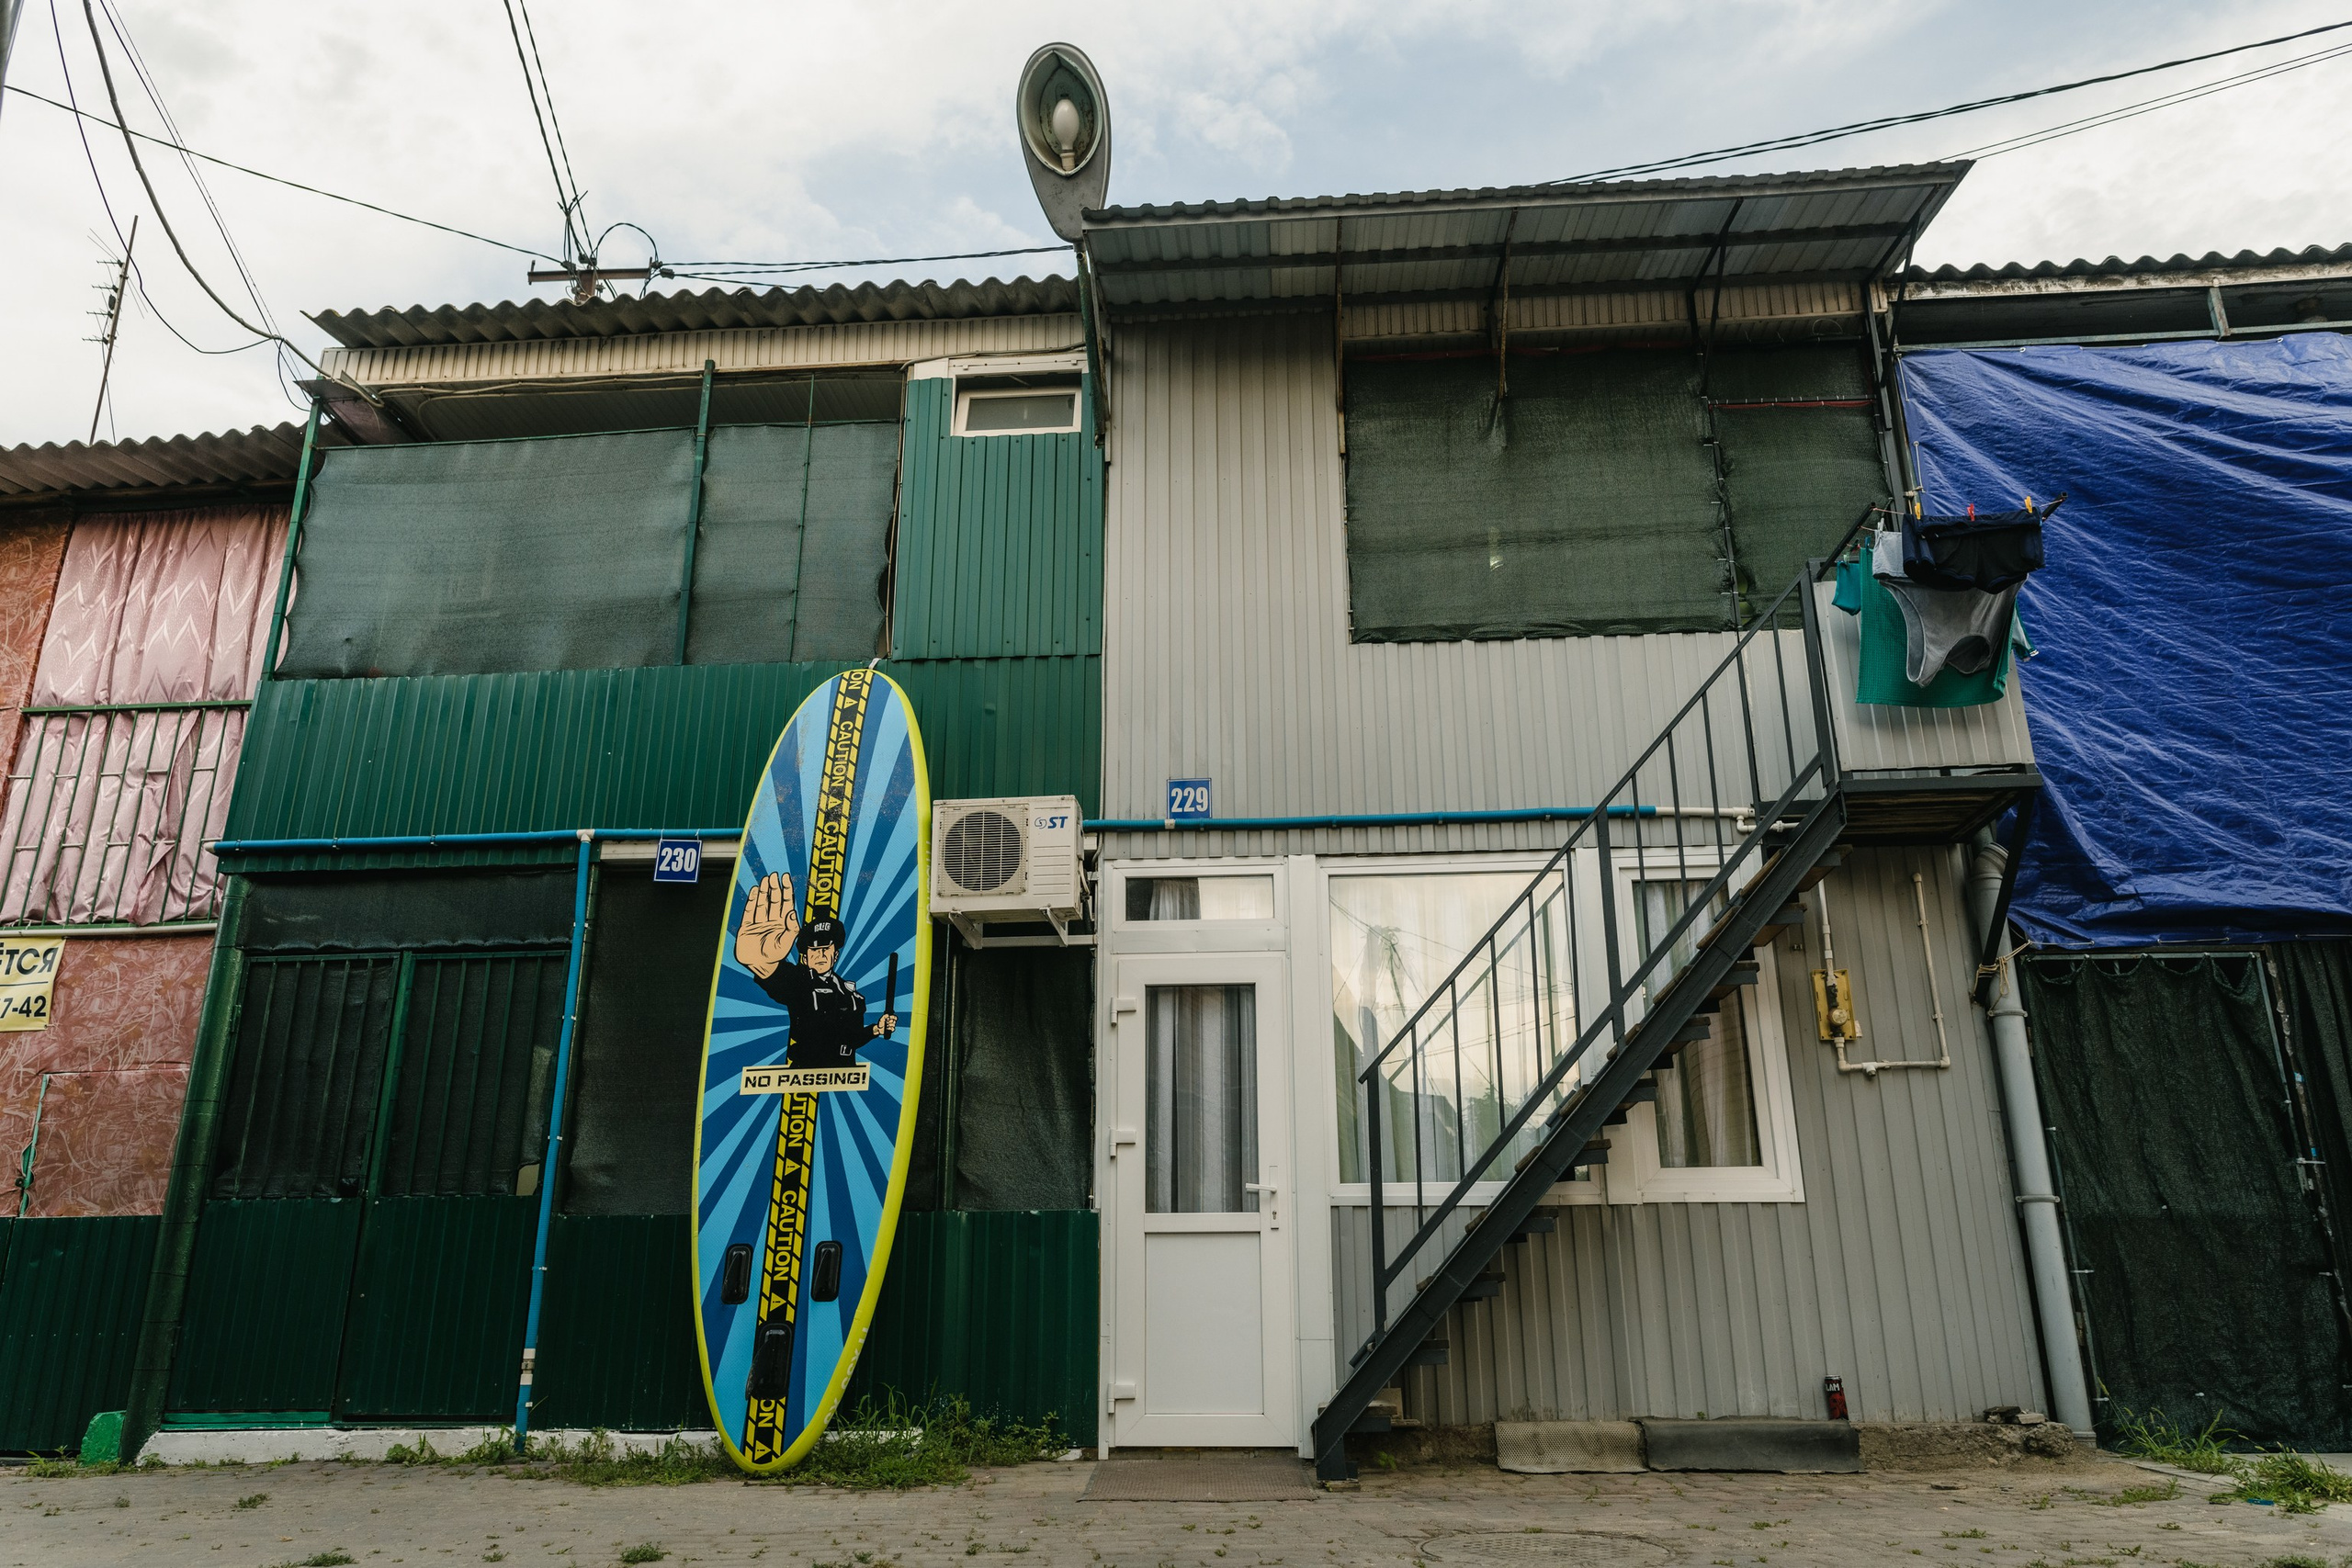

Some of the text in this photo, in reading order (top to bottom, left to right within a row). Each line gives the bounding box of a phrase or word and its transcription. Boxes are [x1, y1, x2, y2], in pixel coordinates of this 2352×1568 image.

[831, 720, 854, 787] CAUTION
[1170, 786, 1209, 813] 229
[1047, 816, 1069, 829] ST
[659, 847, 697, 873] 230
[814, 821, 840, 906] CAUTION
[0, 942, 59, 976] ТСЯ
[0, 995, 47, 1019] 7-42
[744, 1072, 867, 1089] NO PASSING!
[773, 1190, 797, 1281] CAUTION
